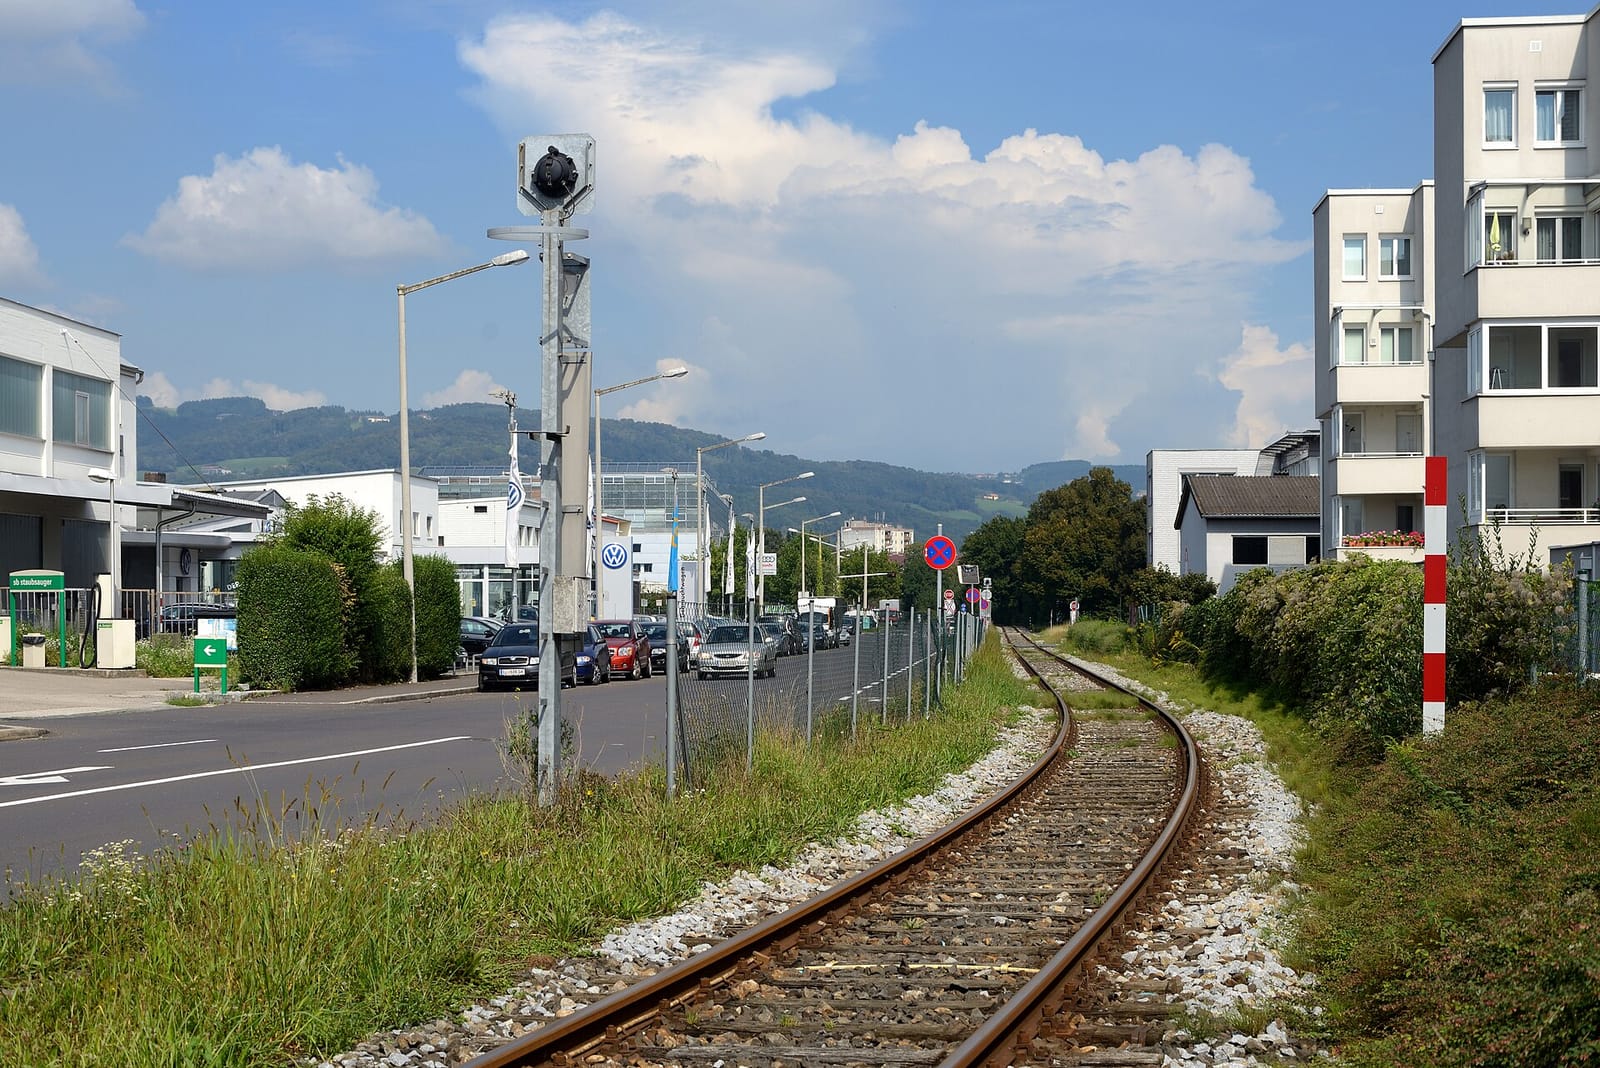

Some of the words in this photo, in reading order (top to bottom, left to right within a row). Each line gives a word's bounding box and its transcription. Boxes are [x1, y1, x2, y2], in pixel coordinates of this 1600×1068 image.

[603, 544, 627, 569] VW
[13, 578, 20, 586] sb
[20, 578, 53, 588] staubsauger
